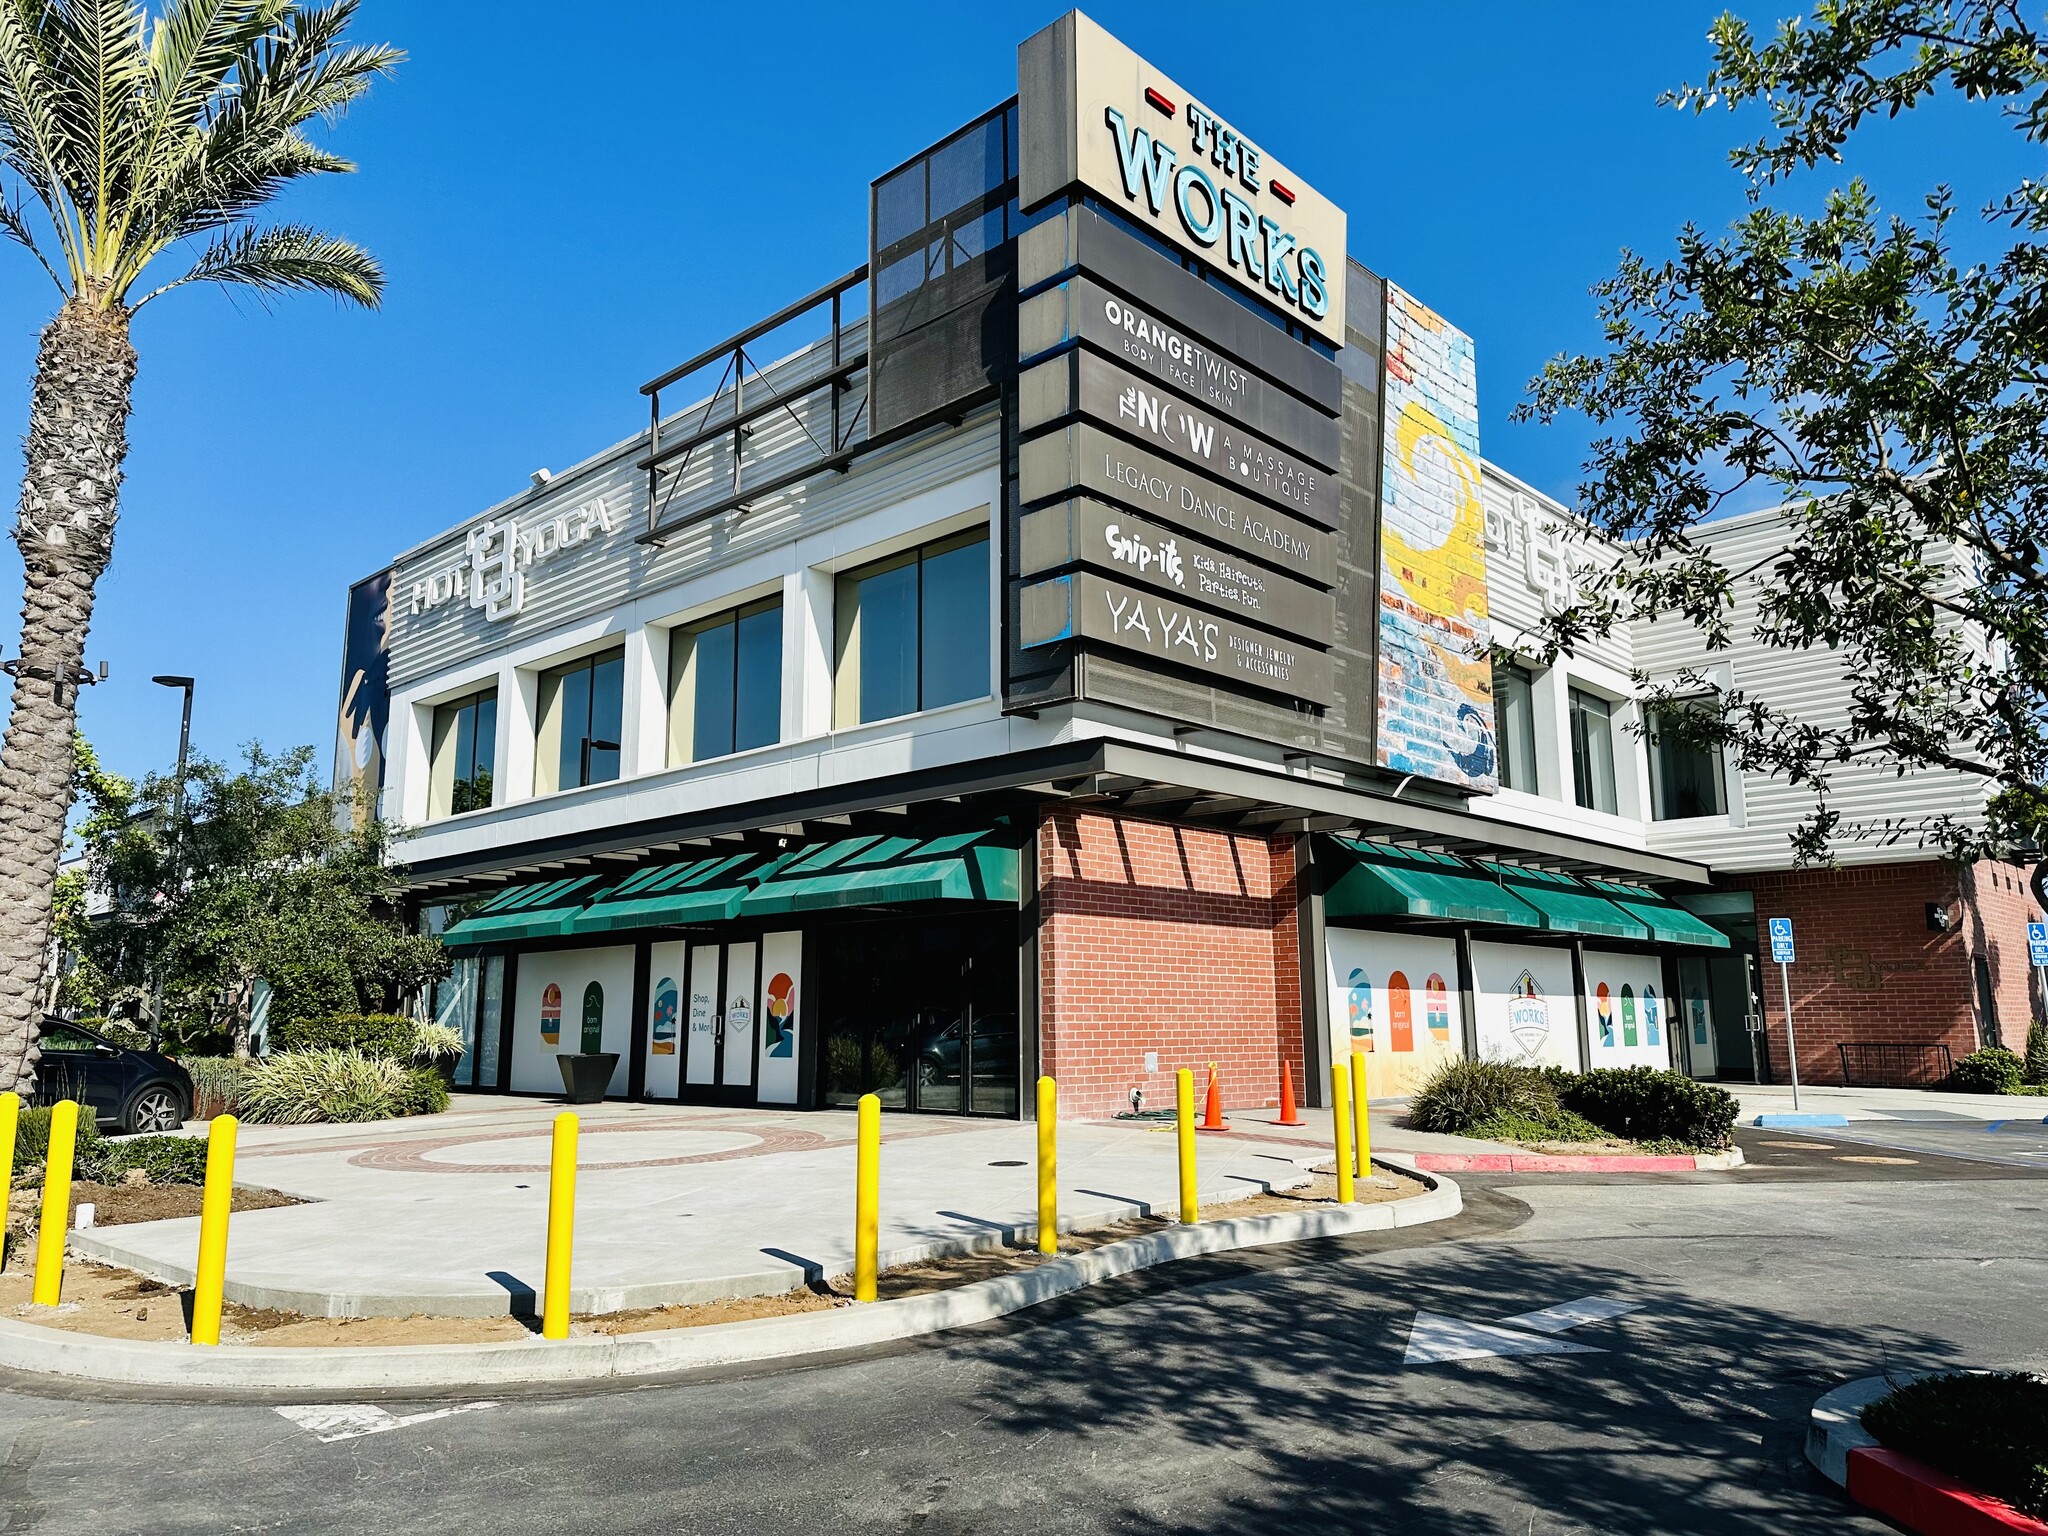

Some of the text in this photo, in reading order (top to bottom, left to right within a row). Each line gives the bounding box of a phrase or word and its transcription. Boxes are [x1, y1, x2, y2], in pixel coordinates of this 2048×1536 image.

[1186, 102, 1260, 196] THE
[1104, 105, 1329, 321] WORKS
[1104, 300, 1248, 395] ORANGETWIST
[1124, 339, 1233, 407] BODY FACE SKIN
[1137, 390, 1214, 459] NOW
[1223, 436, 1315, 490] A MASSAGE
[1229, 456, 1310, 506] BOUTIQUE
[1105, 454, 1311, 561] LEGACY DANCE ACADEMY
[411, 560, 469, 615] HOT
[516, 498, 611, 566] YOGA
[1193, 555, 1265, 592] Kids. Haircuts.
[1199, 573, 1261, 609] Parties. Fun.
[1229, 635, 1295, 667] DESIGNER JEWELRY
[1245, 657, 1289, 681] ACCESSORIES
[692, 1008, 706, 1018] Dine
[693, 993, 709, 1005] Shop,
[1513, 1008, 1545, 1025] WORKS
